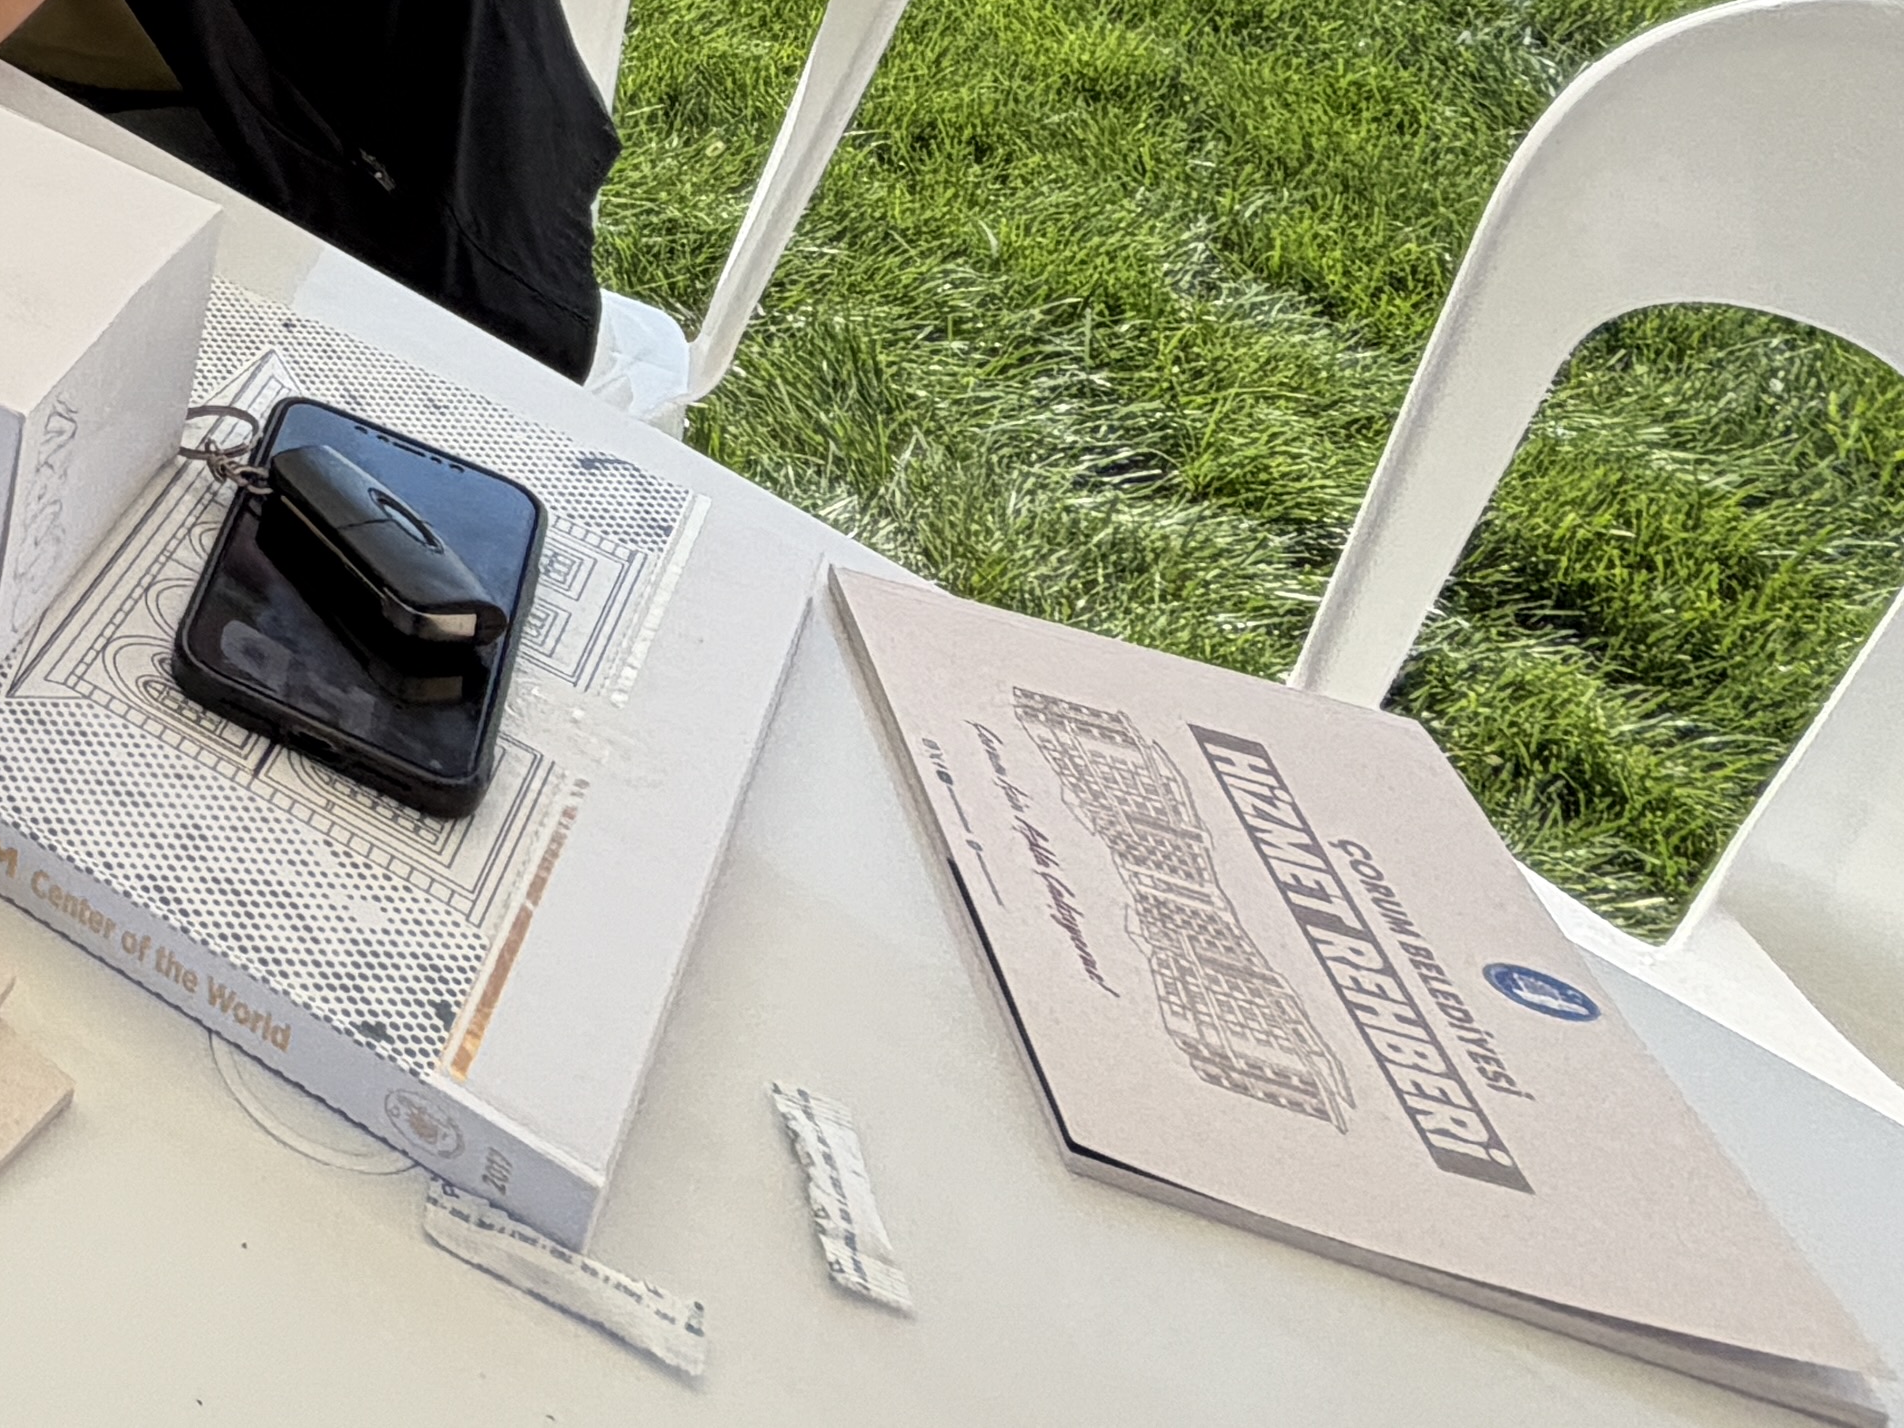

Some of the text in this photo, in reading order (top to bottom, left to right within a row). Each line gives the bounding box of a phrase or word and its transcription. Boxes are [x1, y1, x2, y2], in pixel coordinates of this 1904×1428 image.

[30, 868, 116, 942] Center
[120, 924, 155, 967] of
[154, 941, 201, 994] the
[206, 976, 294, 1053] World
[1207, 746, 1514, 1170] HİZMET REHBERİ
[1328, 835, 1534, 1102] ÇORUM BELEDİYESİ
